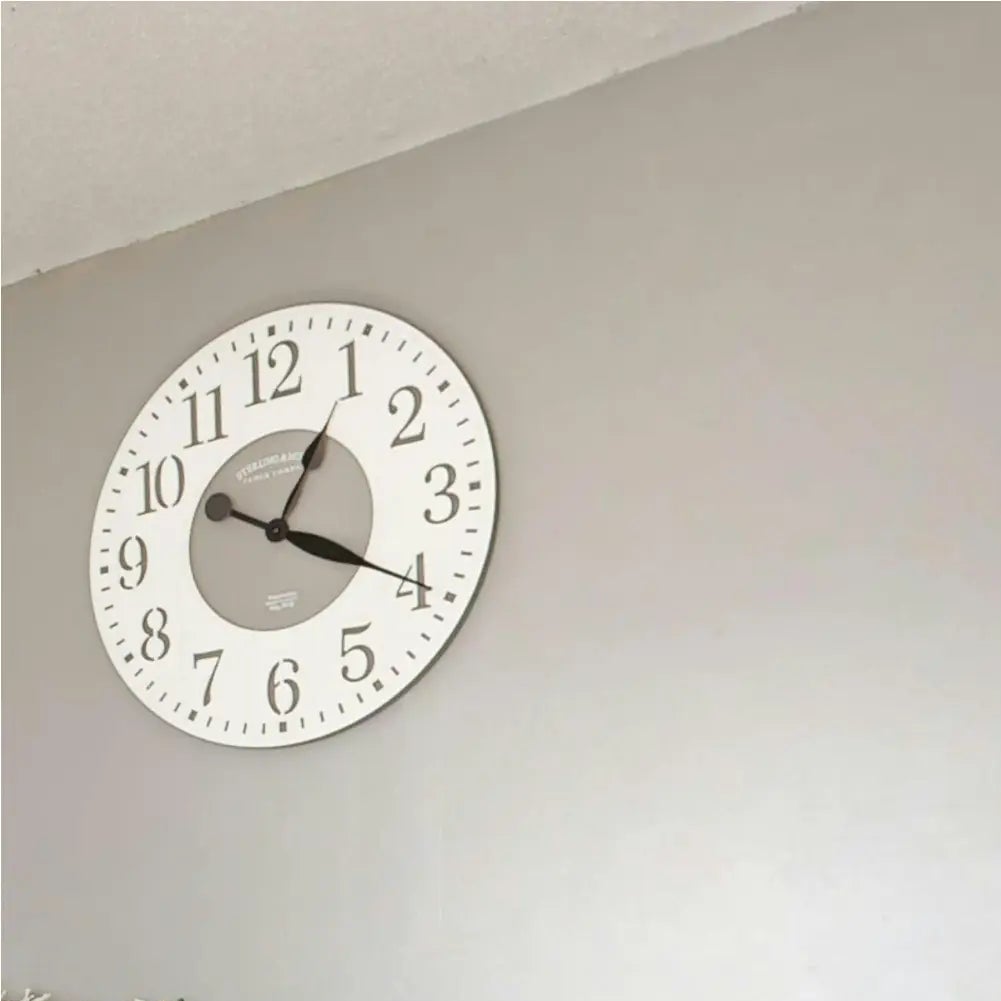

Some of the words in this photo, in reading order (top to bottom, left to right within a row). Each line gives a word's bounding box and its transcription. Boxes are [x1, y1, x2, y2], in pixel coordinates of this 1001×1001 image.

[244, 339, 302, 407] 12
[338, 340, 363, 401] 1
[183, 384, 228, 449] 11
[388, 385, 426, 448] 2
[136, 455, 185, 516] 10
[424, 463, 460, 524] 3
[119, 535, 148, 591] 9
[396, 552, 431, 611] 4
[140, 606, 171, 661] 8
[341, 622, 375, 682] 5
[193, 649, 224, 706] 7
[266, 658, 300, 716] 6
